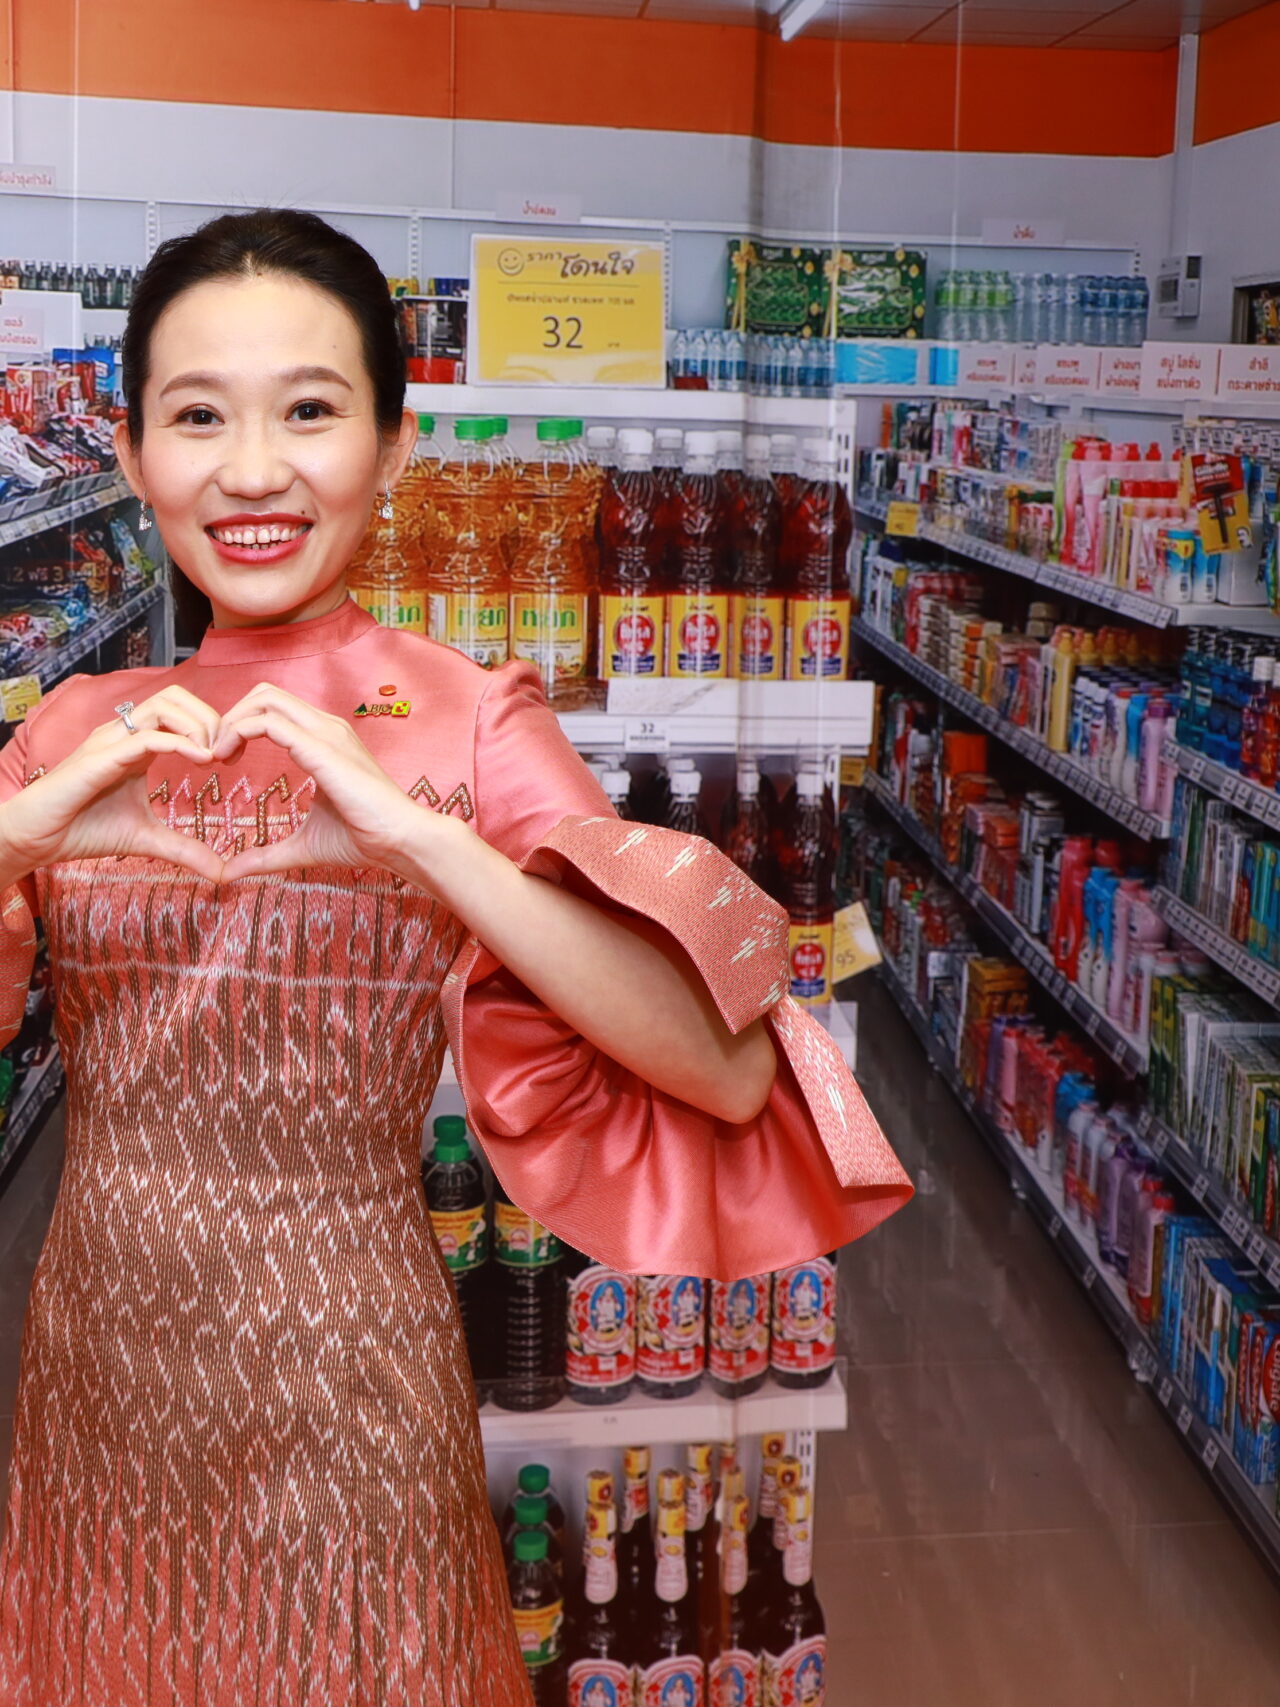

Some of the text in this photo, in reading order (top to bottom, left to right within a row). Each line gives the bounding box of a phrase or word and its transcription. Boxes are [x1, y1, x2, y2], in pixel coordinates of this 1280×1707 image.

[526, 251, 635, 279] ราคา โดนใจ
[542, 316, 583, 349] 32
